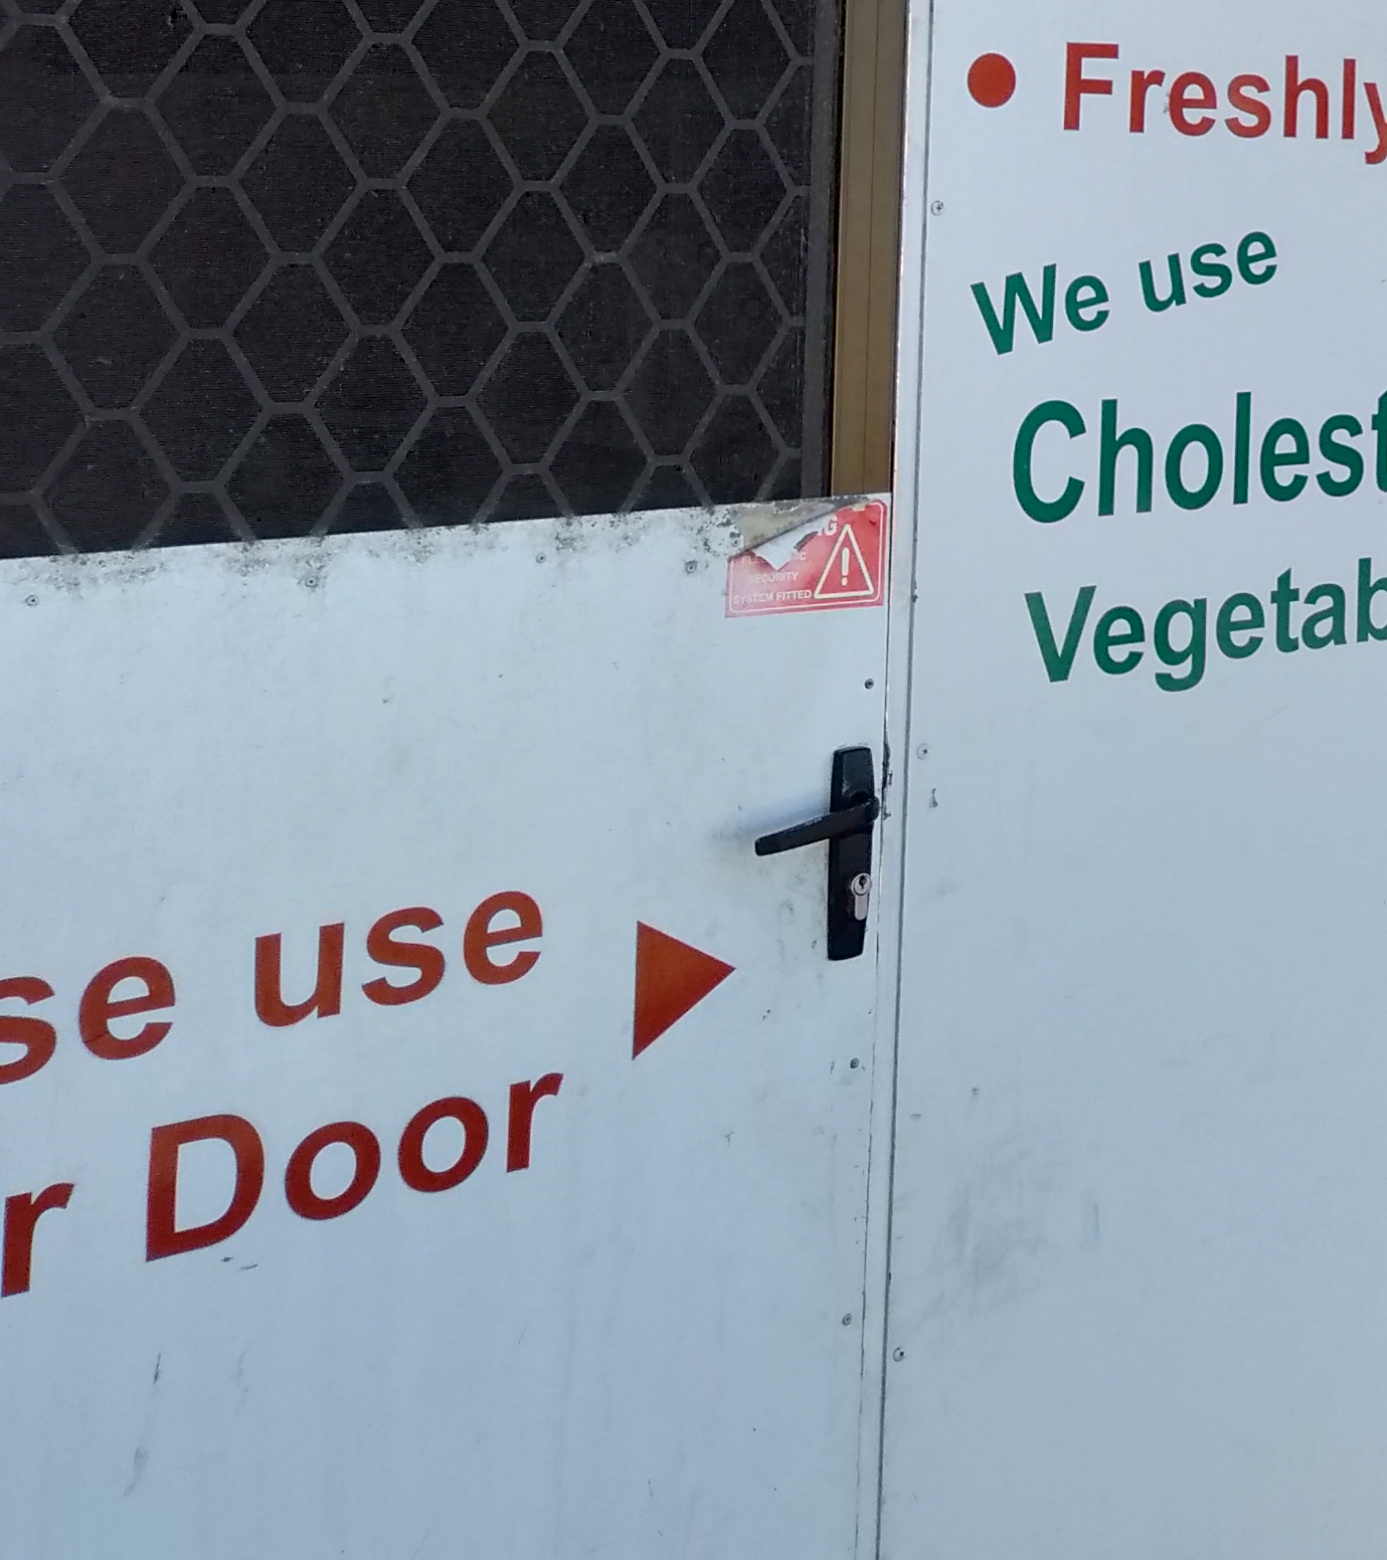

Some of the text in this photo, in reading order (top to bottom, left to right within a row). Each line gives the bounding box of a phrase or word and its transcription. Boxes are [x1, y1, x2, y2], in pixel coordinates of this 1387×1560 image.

[970, 232, 1277, 355] We use
[733, 589, 812, 605] SYSTEM FITTED
[748, 571, 799, 584] SECURITY
[255, 891, 542, 1027] use
[146, 1073, 563, 1262] Door
